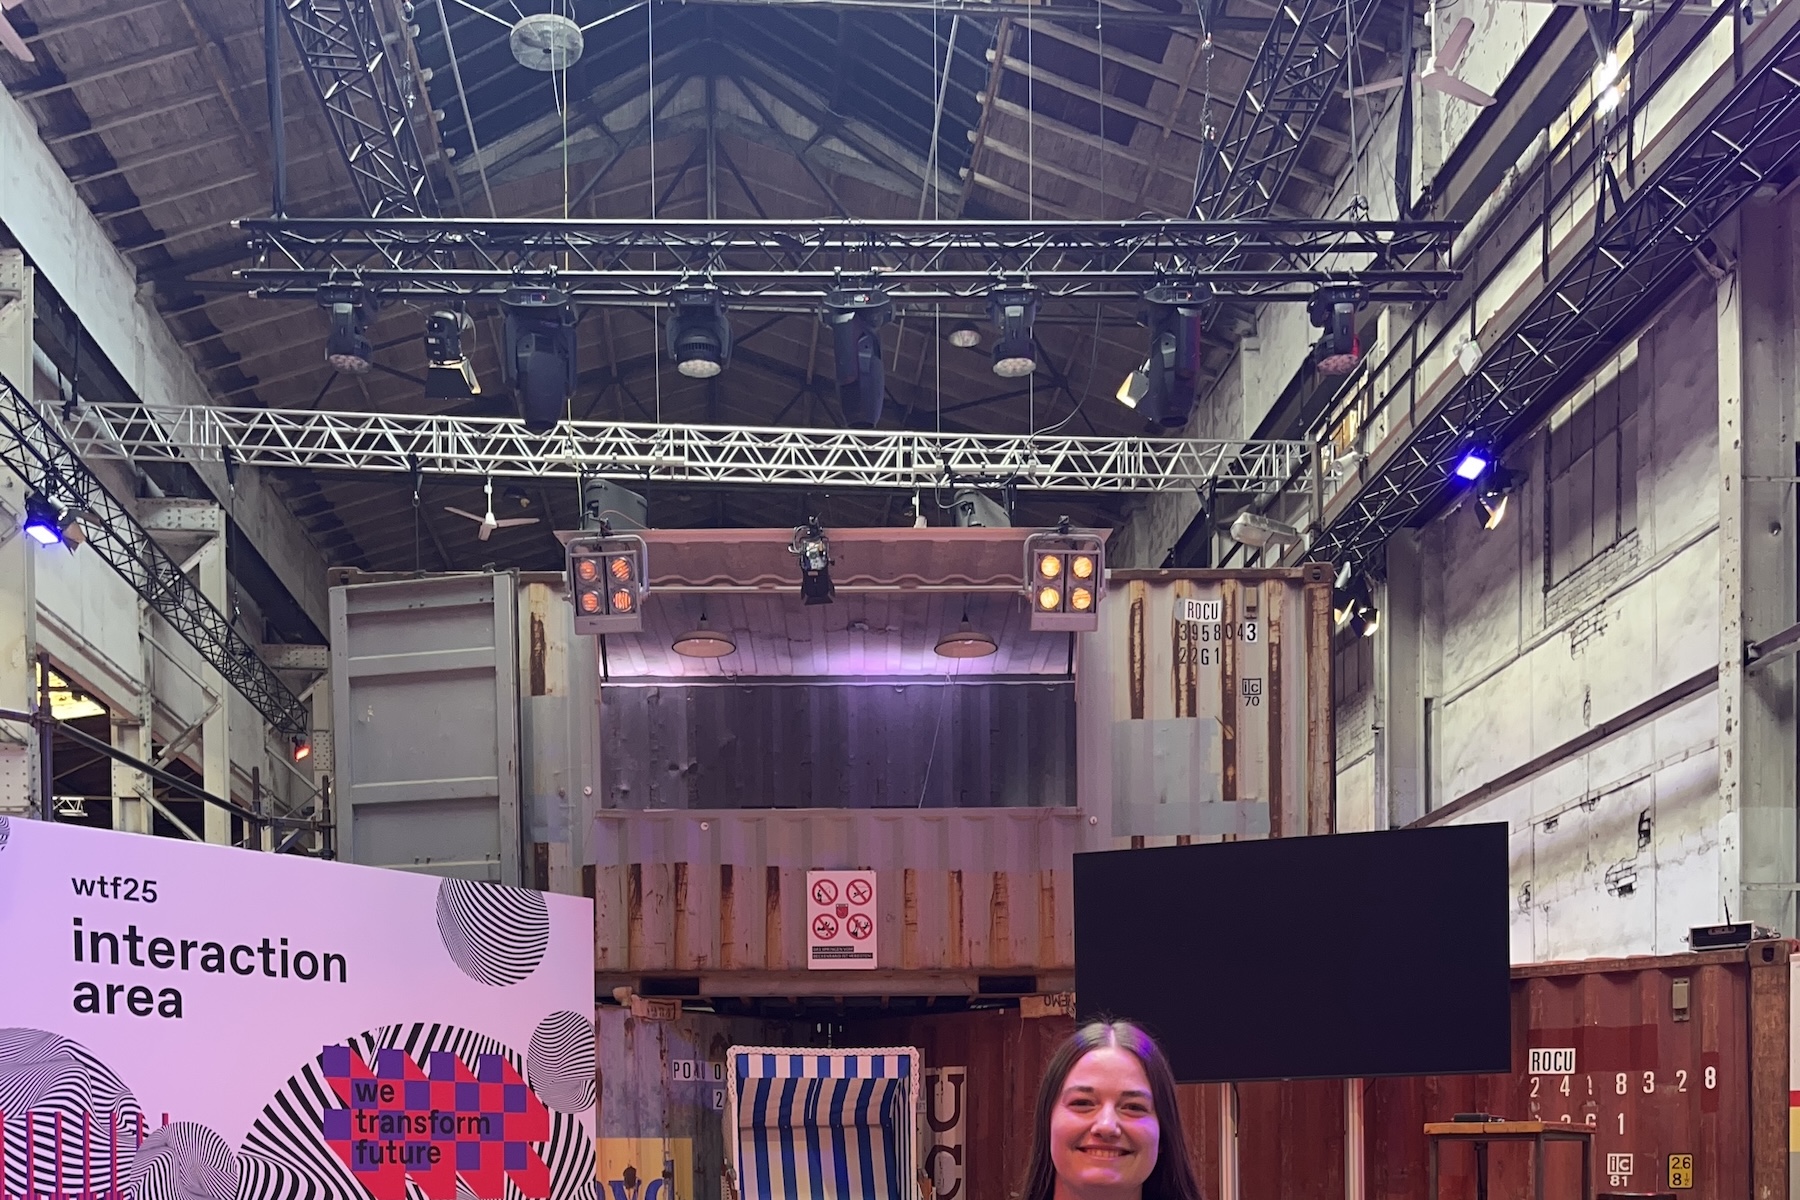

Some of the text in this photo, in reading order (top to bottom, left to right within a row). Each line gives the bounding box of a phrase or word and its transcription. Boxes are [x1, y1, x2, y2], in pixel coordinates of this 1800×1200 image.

[1187, 602, 1219, 619] ROCU
[1244, 696, 1260, 706] 70
[71, 876, 158, 903] wtf25
[73, 917, 347, 983] interaction
[73, 981, 183, 1018] area
[1532, 1052, 1573, 1071] ROCU
[355, 1083, 395, 1103] we
[355, 1109, 490, 1134] transform
[356, 1139, 441, 1164] future
[1610, 1175, 1628, 1187] 81
